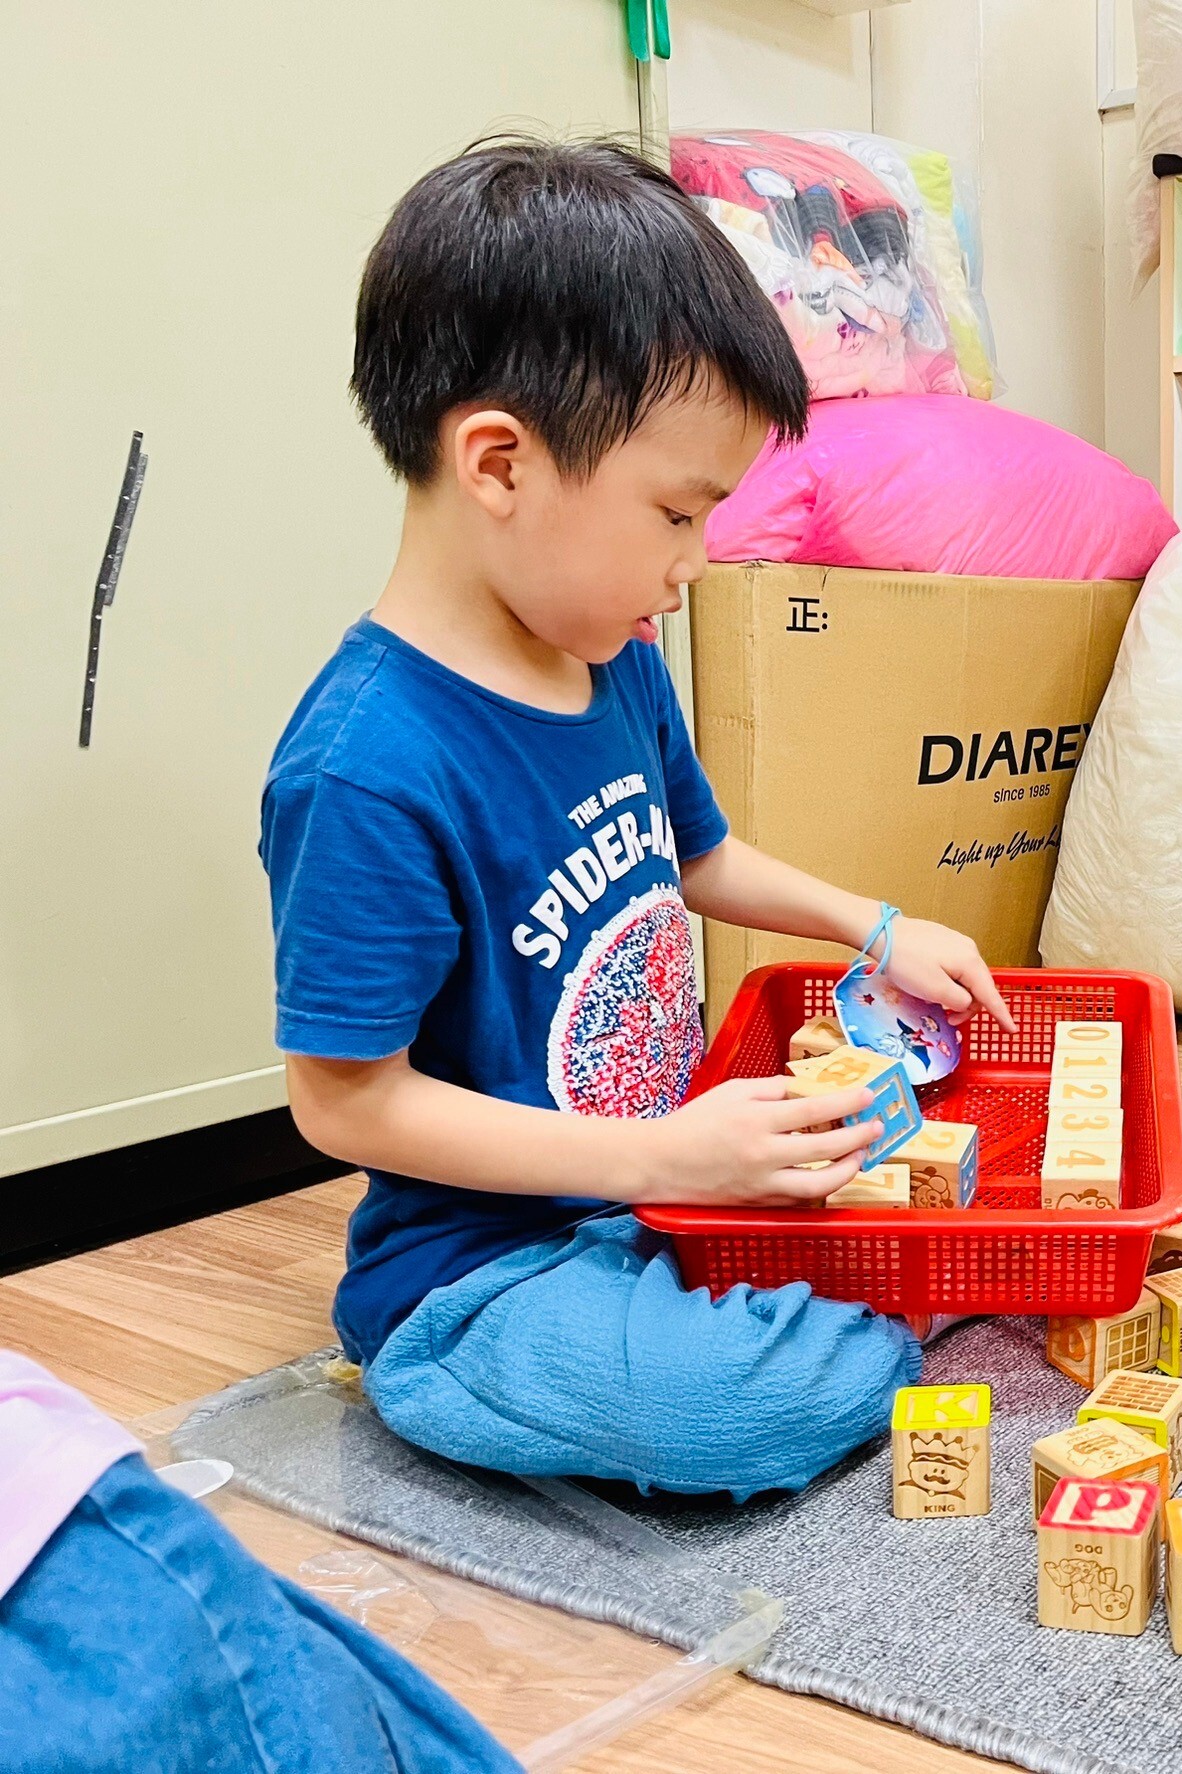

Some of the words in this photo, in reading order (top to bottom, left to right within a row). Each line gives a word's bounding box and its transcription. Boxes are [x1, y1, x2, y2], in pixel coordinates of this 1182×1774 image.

[993, 788, 1025, 803] since
[1029, 784, 1051, 798] 1985
[567, 795, 604, 829] THE
[937, 841, 983, 874] Light
[984, 843, 1005, 868] up
[1006, 830, 1045, 860] Your
[512, 804, 682, 969] SPIDER-MA
[1063, 1056, 1107, 1068] 1
[1062, 1084, 1108, 1099] 2
[1061, 1113, 1110, 1132] 3
[1056, 1150, 1106, 1168] 4
[908, 1392, 975, 1422] K
[924, 1504, 956, 1513] KING
[1069, 1486, 1132, 1521] P
[1074, 1544, 1103, 1554] DOG
